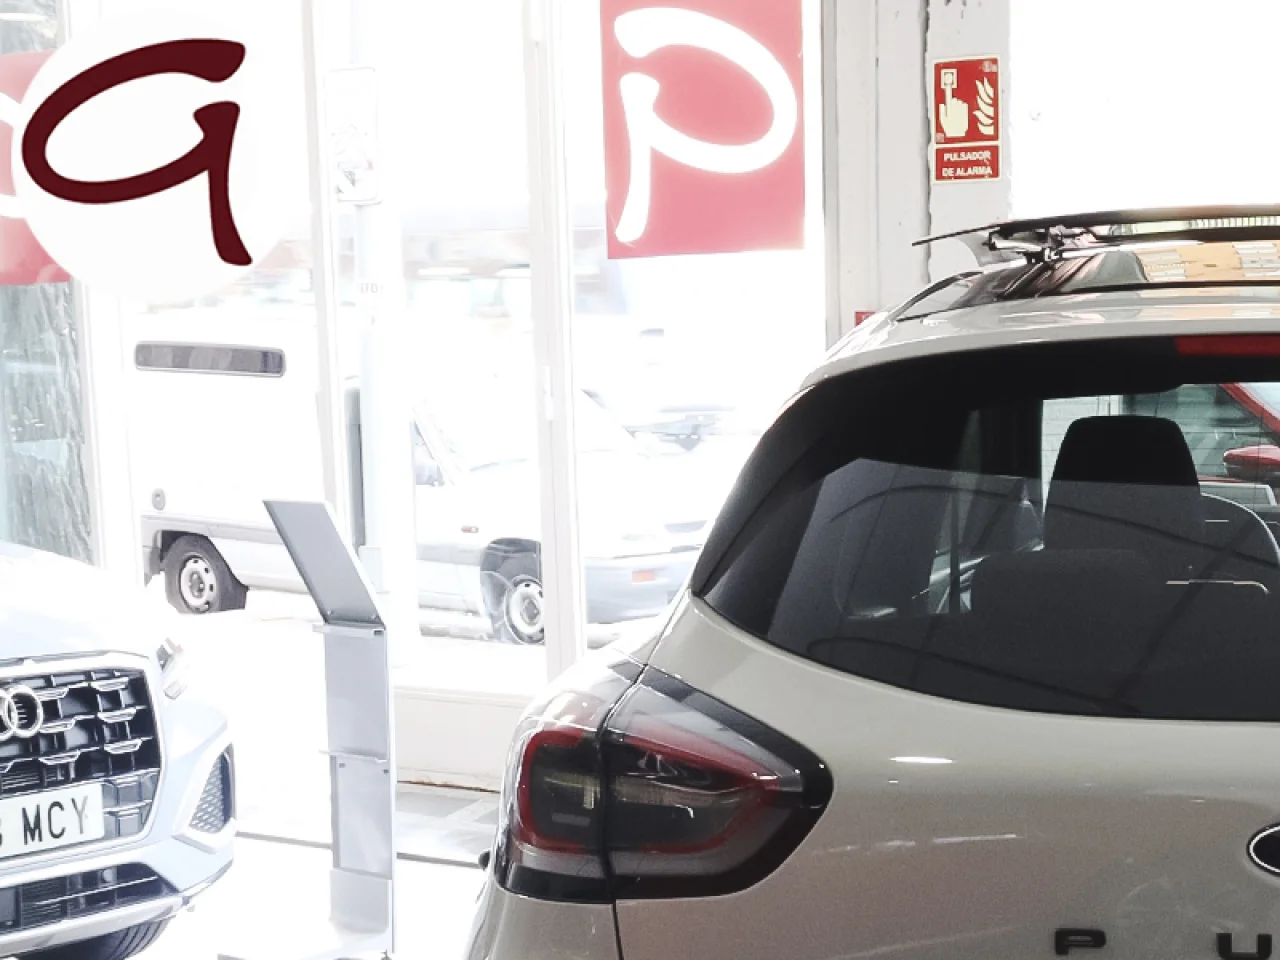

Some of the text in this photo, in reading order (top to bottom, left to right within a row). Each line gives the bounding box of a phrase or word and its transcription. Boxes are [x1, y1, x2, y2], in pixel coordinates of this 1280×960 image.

[943, 150, 991, 162] PULSADOR
[941, 165, 993, 177] DE ALARMA
[22, 795, 88, 846] MCY
